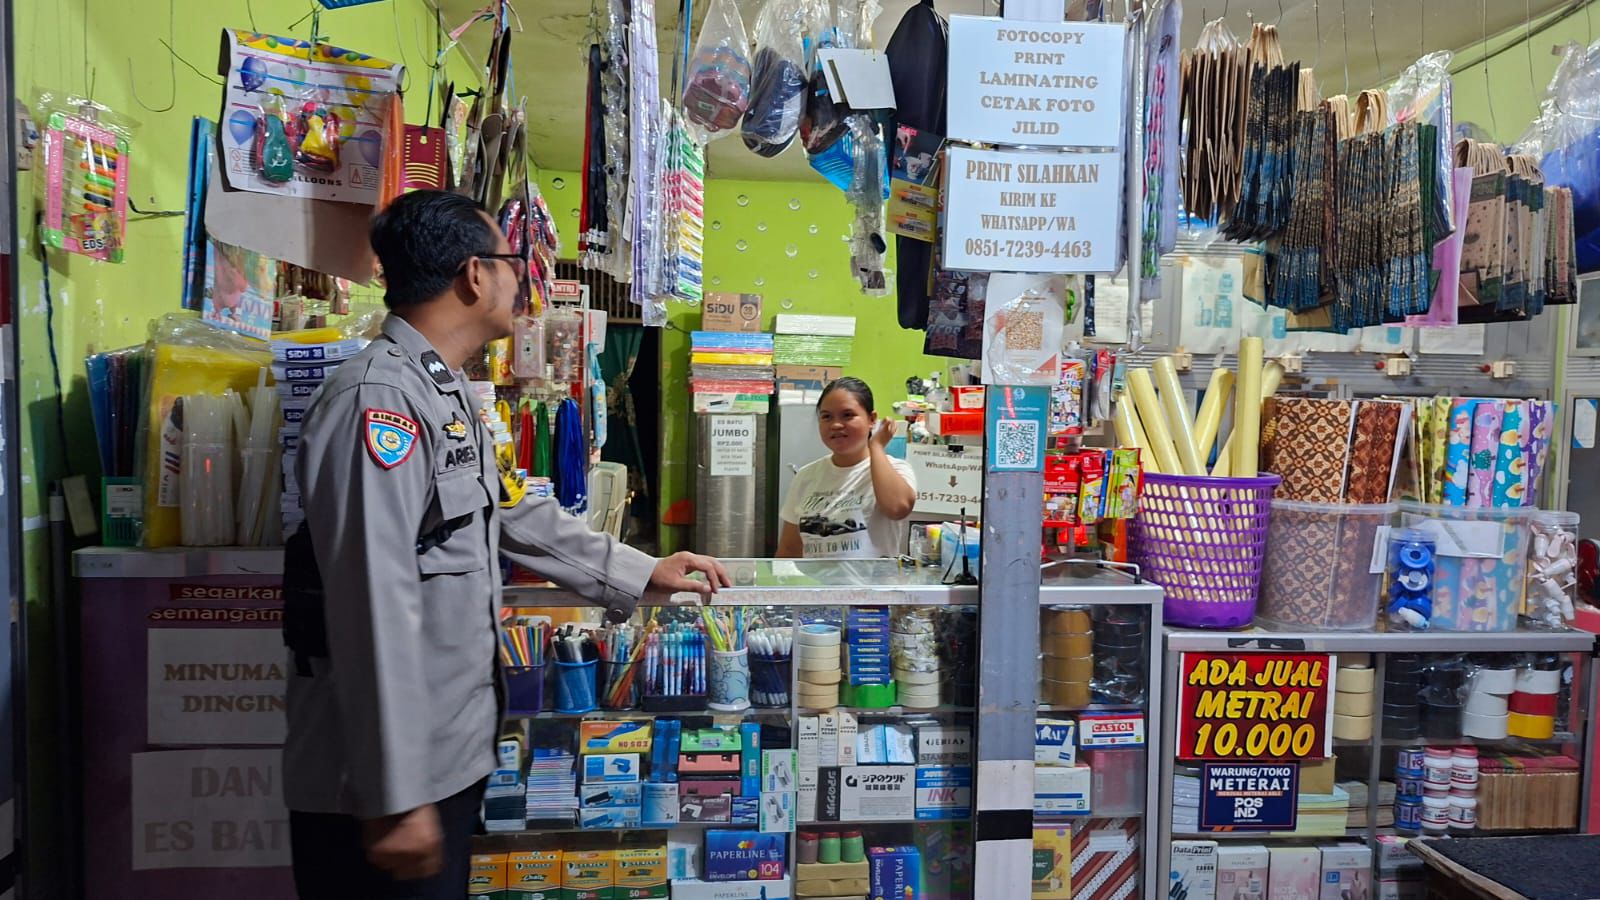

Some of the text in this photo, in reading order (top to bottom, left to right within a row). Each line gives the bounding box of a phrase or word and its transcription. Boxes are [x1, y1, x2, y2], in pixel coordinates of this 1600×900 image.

[997, 29, 1085, 44] FOTOCOPY
[1014, 52, 1065, 65] PRINT
[980, 71, 1098, 89] LAMINATING
[981, 95, 1095, 112] CETAK FOTO
[1012, 121, 1060, 135] JILID
[966, 160, 1099, 183] PRINT SILAHKAN
[1000, 192, 1056, 207] KIRIM KE
[981, 214, 1076, 231] WHATSAPP/WA
[965, 238, 1092, 258] 0851-7239-4463
[712, 429, 749, 437] JUMBO
[841, 539, 860, 551] WIN
[1189, 659, 1323, 687] ADA JUAL
[1195, 690, 1315, 721] METRAI
[1093, 724, 1133, 732] CASTOL
[1194, 723, 1316, 757] 10.000
[1211, 767, 1291, 777] WARUNG/TOKO
[191, 766, 272, 798] DAN
[1210, 778, 1290, 791] METERAI
[928, 788, 957, 802] INK
[1234, 797, 1264, 808] POS
[144, 821, 195, 853] ES
[710, 850, 765, 859] PAPERLINE
[761, 864, 779, 874] 104
